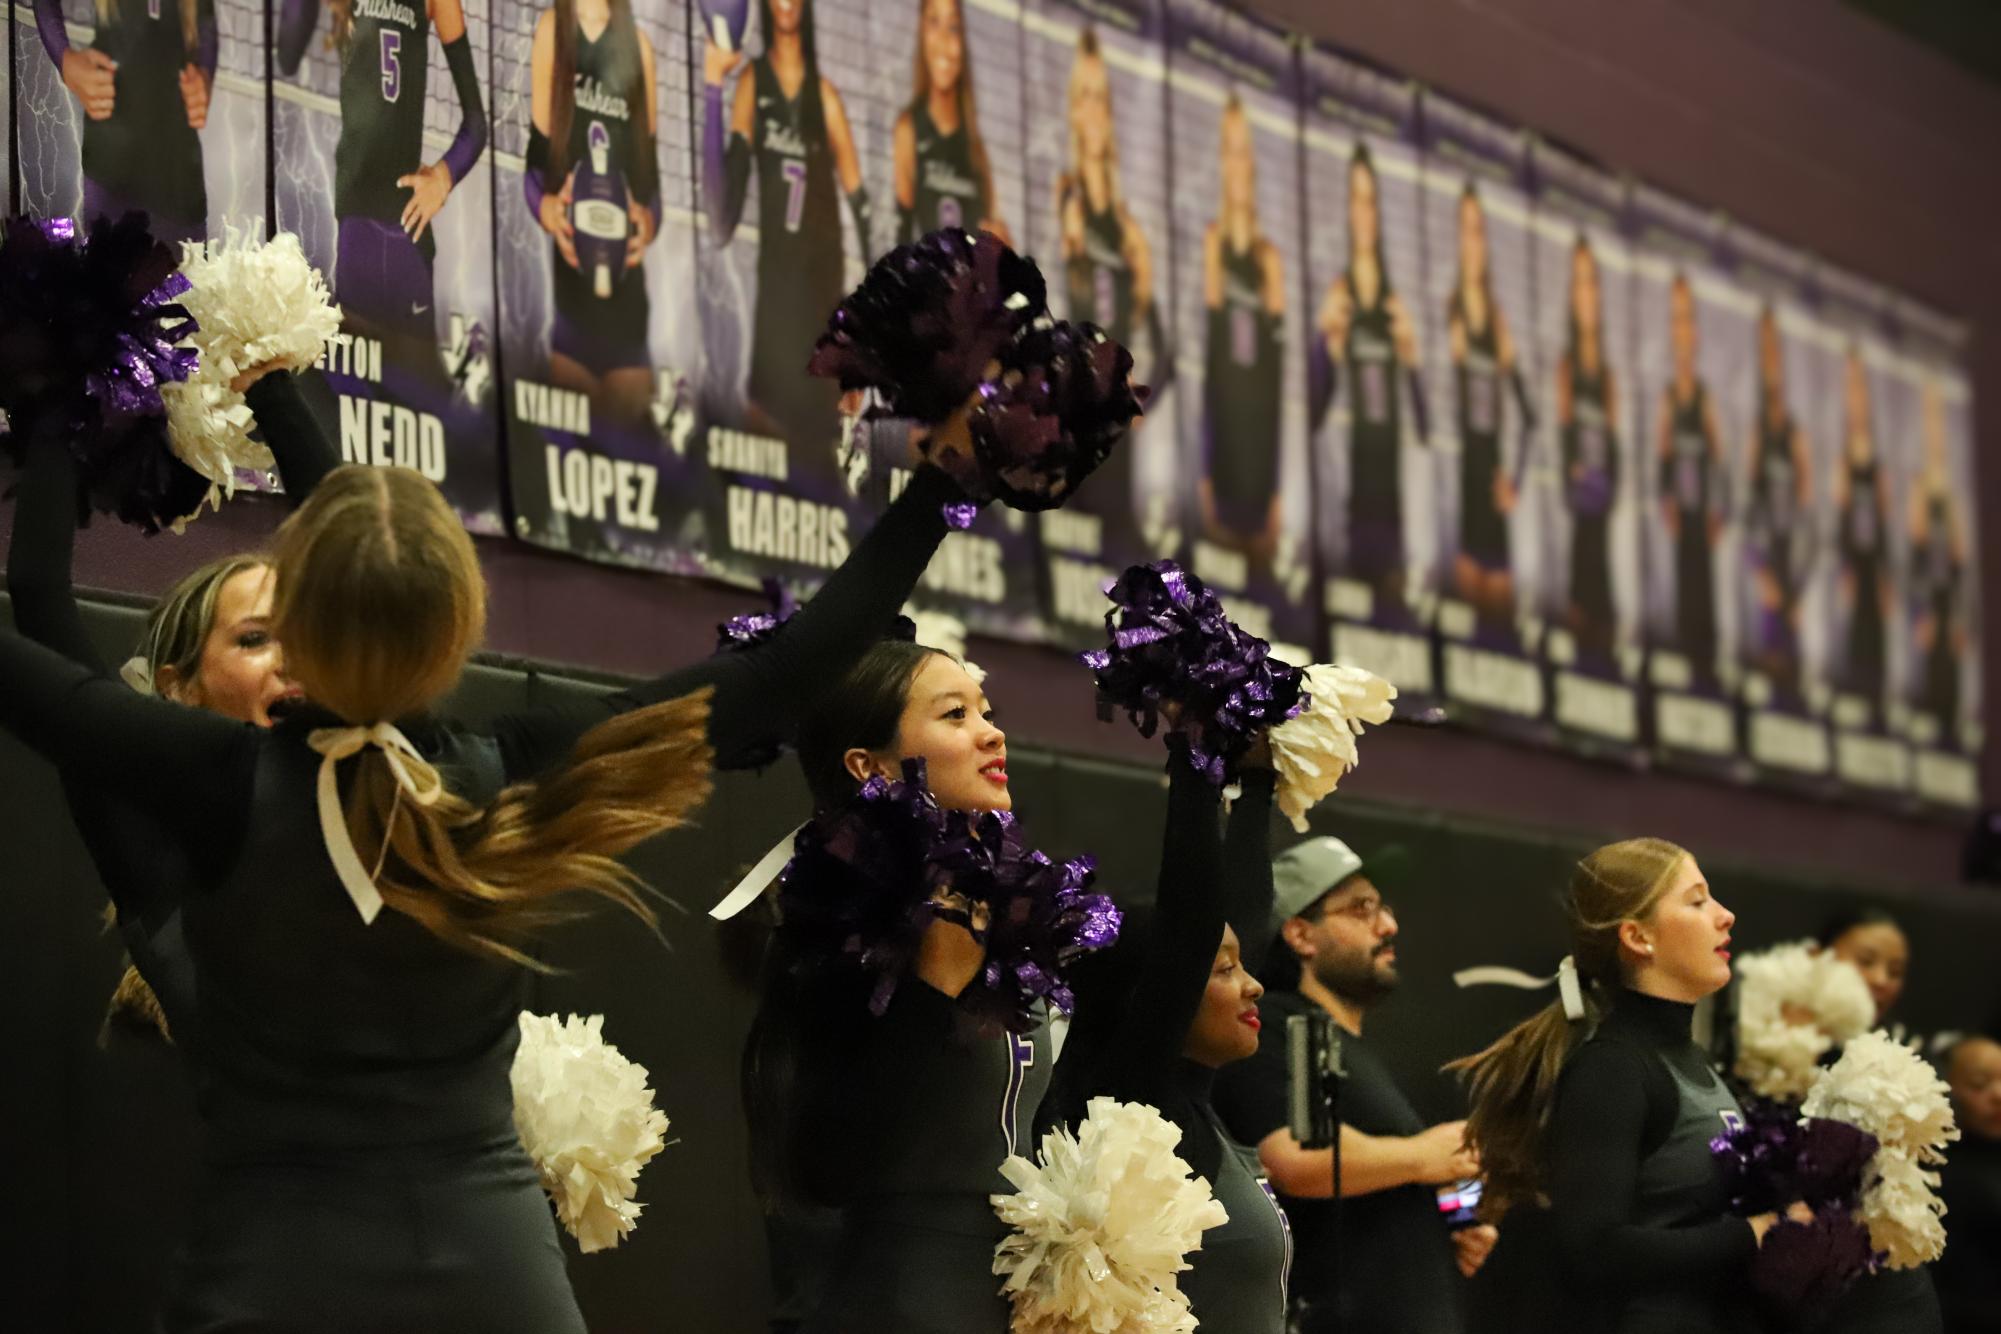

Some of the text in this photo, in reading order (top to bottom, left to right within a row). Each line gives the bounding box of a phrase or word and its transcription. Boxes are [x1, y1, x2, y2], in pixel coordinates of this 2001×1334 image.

[380, 28, 401, 103] 5
[782, 159, 806, 232] 7
[339, 394, 447, 483] NEDD
[546, 444, 660, 532] LOPEZ
[727, 484, 851, 570] HARRIS
